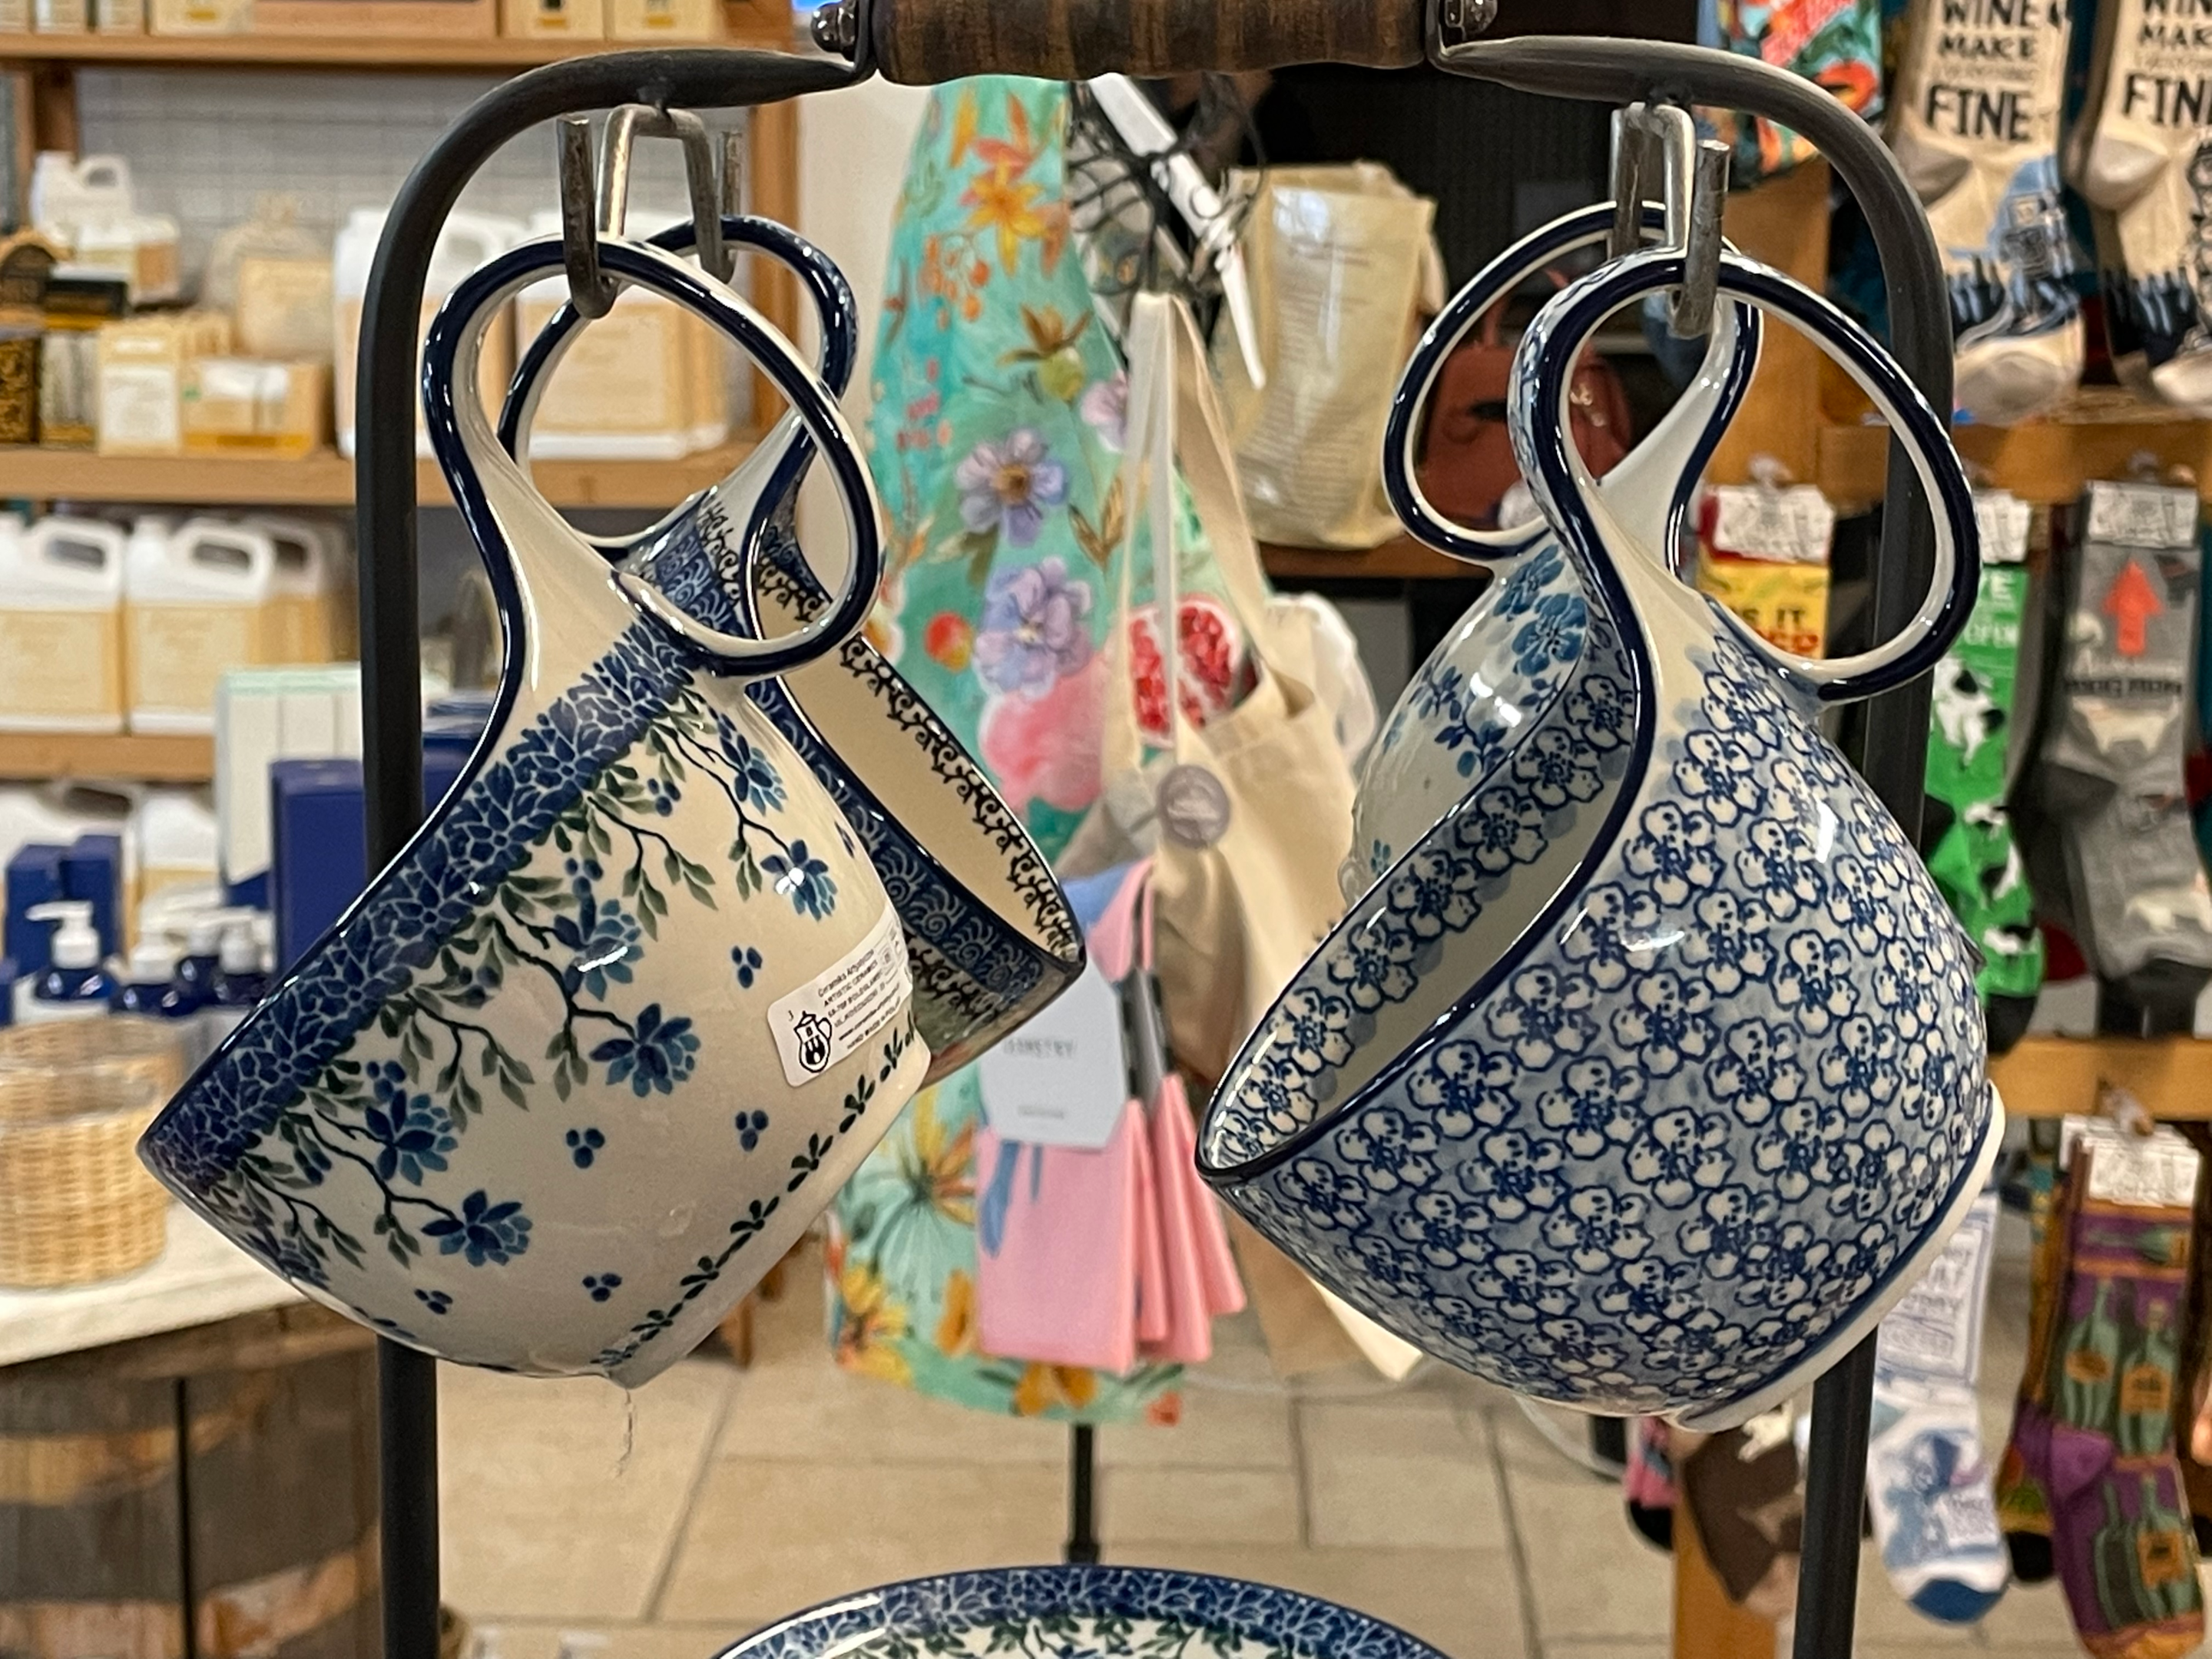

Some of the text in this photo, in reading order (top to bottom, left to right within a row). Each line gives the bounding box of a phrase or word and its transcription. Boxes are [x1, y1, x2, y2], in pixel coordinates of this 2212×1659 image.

[1942, 0, 2037, 28] WINE
[1939, 36, 2037, 61] MAKE
[1926, 83, 2034, 141] FINE
[2122, 71, 2212, 129] FIN
